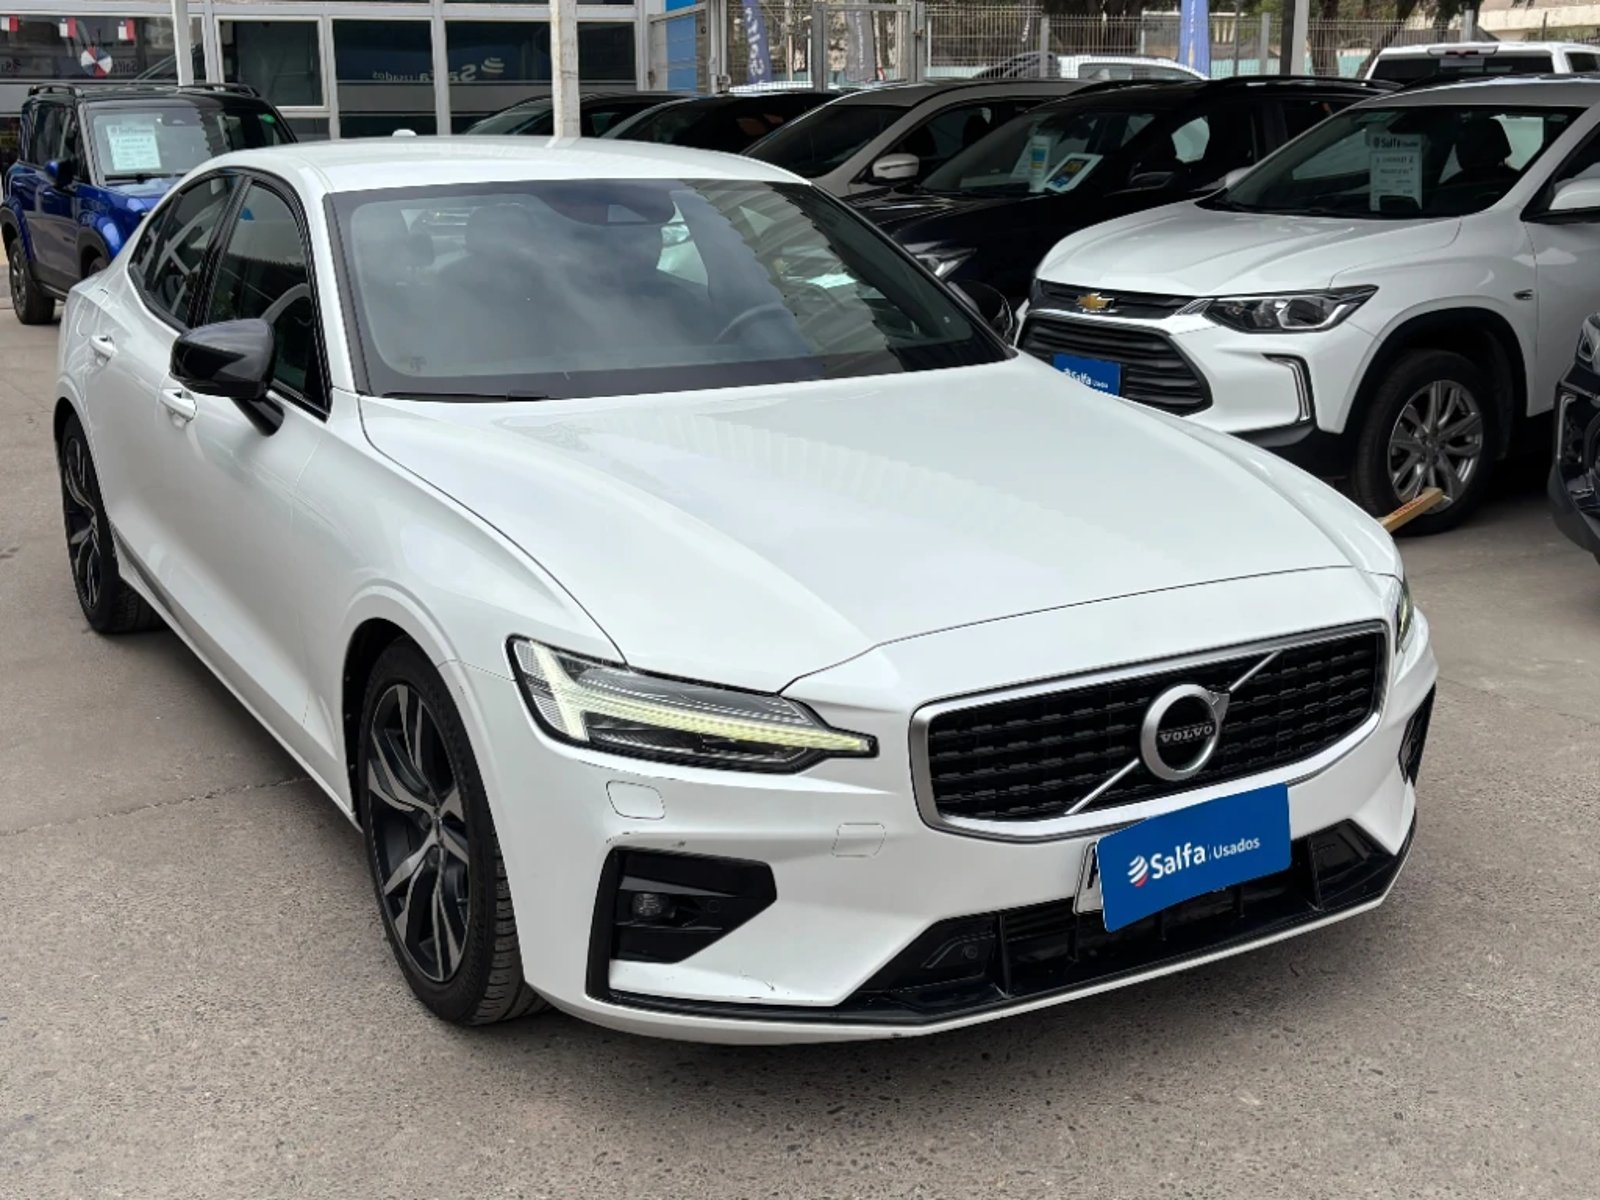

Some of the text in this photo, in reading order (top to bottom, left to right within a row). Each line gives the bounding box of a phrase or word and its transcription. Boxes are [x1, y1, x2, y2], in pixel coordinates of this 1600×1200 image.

[1161, 725, 1213, 743] VOLVO
[1150, 837, 1261, 879] Salfa Usados
